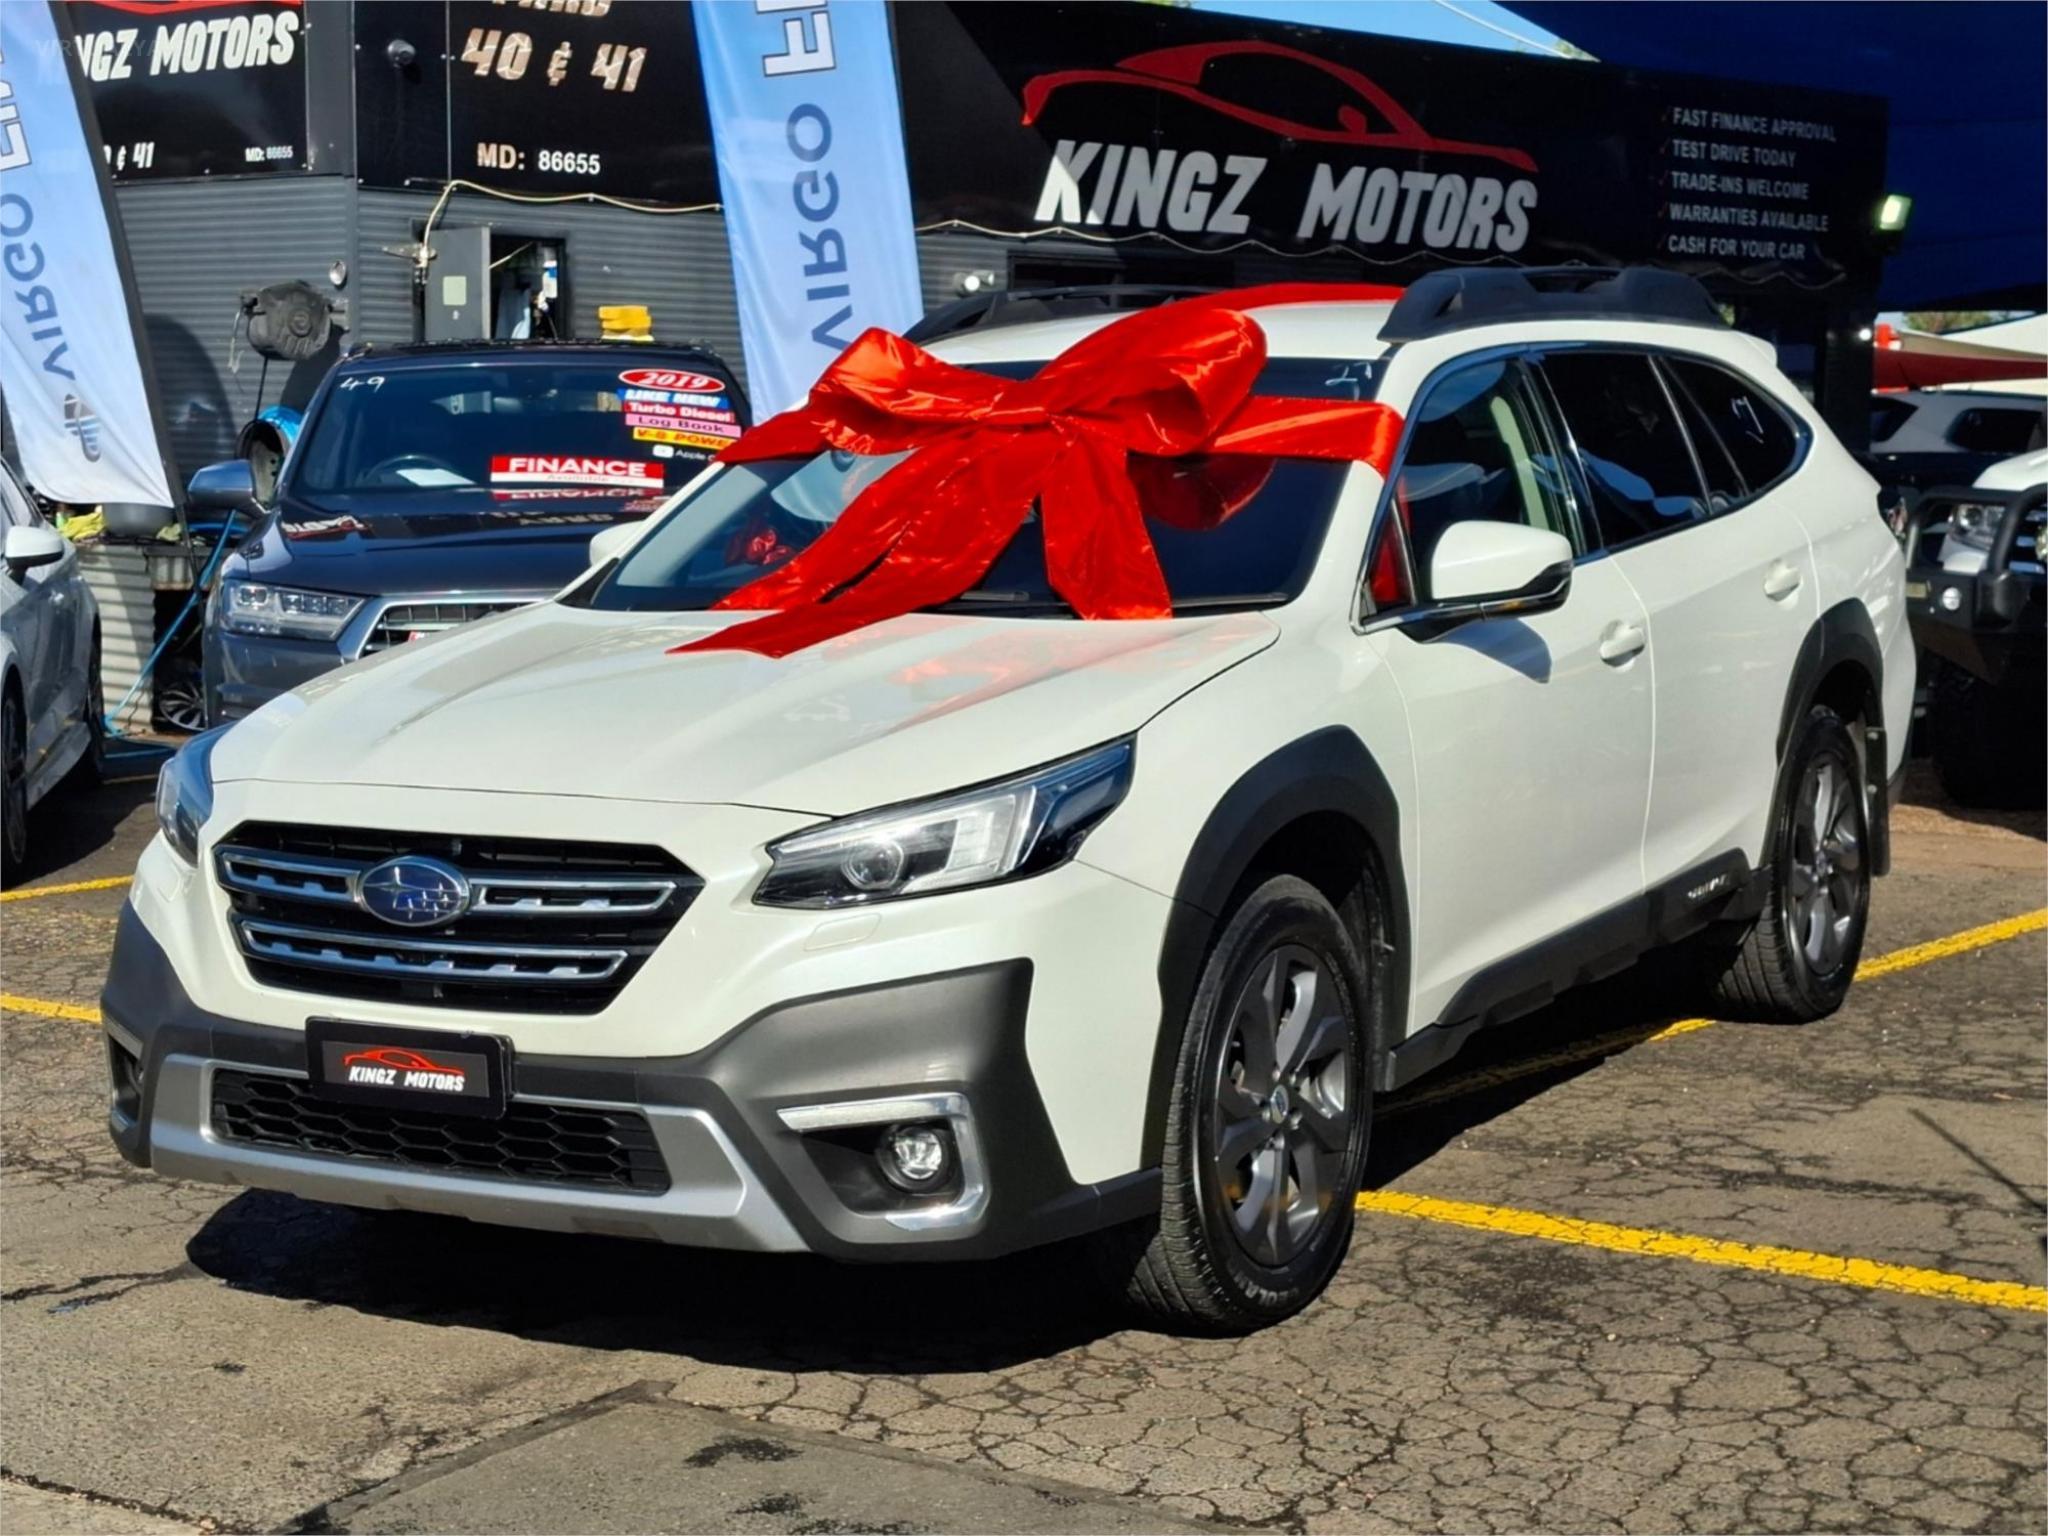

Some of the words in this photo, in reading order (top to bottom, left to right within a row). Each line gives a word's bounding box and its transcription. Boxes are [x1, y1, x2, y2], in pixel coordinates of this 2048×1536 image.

[75, 28, 139, 82] NGZ
[150, 10, 299, 77] MOTORS
[461, 28, 533, 81] 40
[590, 43, 647, 92] 41
[1673, 107, 1707, 127] FAST
[1712, 112, 1768, 133] FINANCE
[1772, 119, 1836, 142] APPROVAL
[132, 141, 155, 169] 41
[477, 142, 525, 170] MD:
[538, 150, 600, 175] 86655
[1673, 139, 1706, 158] TEST
[1710, 144, 1749, 163] DRIVE
[1753, 148, 1796, 167] TODAY
[1034, 139, 1268, 235] KINGZ
[1298, 163, 1538, 253] MOTORS
[1671, 172, 1743, 194] TRADE-INS
[1746, 179, 1809, 200] WELCOME
[1670, 204, 1757, 226] WARRANTIES
[1760, 211, 1828, 232] AVAILABLE
[1669, 235, 1706, 253] CASH
[1710, 238, 1737, 255] FOR
[1741, 241, 1775, 257] YOUR
[1779, 243, 1806, 260] CAR
[638, 372, 709, 389] 2019
[624, 390, 670, 402] LIKE
[672, 395, 720, 407] NEW
[628, 403, 675, 415] Turbo
[679, 408, 730, 421] Diesel
[636, 429, 667, 439] V-8
[674, 433, 729, 447] POWE
[638, 417, 670, 427] Log
[678, 420, 723, 432] Book
[509, 457, 647, 477] FINANCE
[675, 450, 705, 460] Apple
[349, 1066, 398, 1086] KINGZ
[404, 1071, 466, 1092] MOTORS
